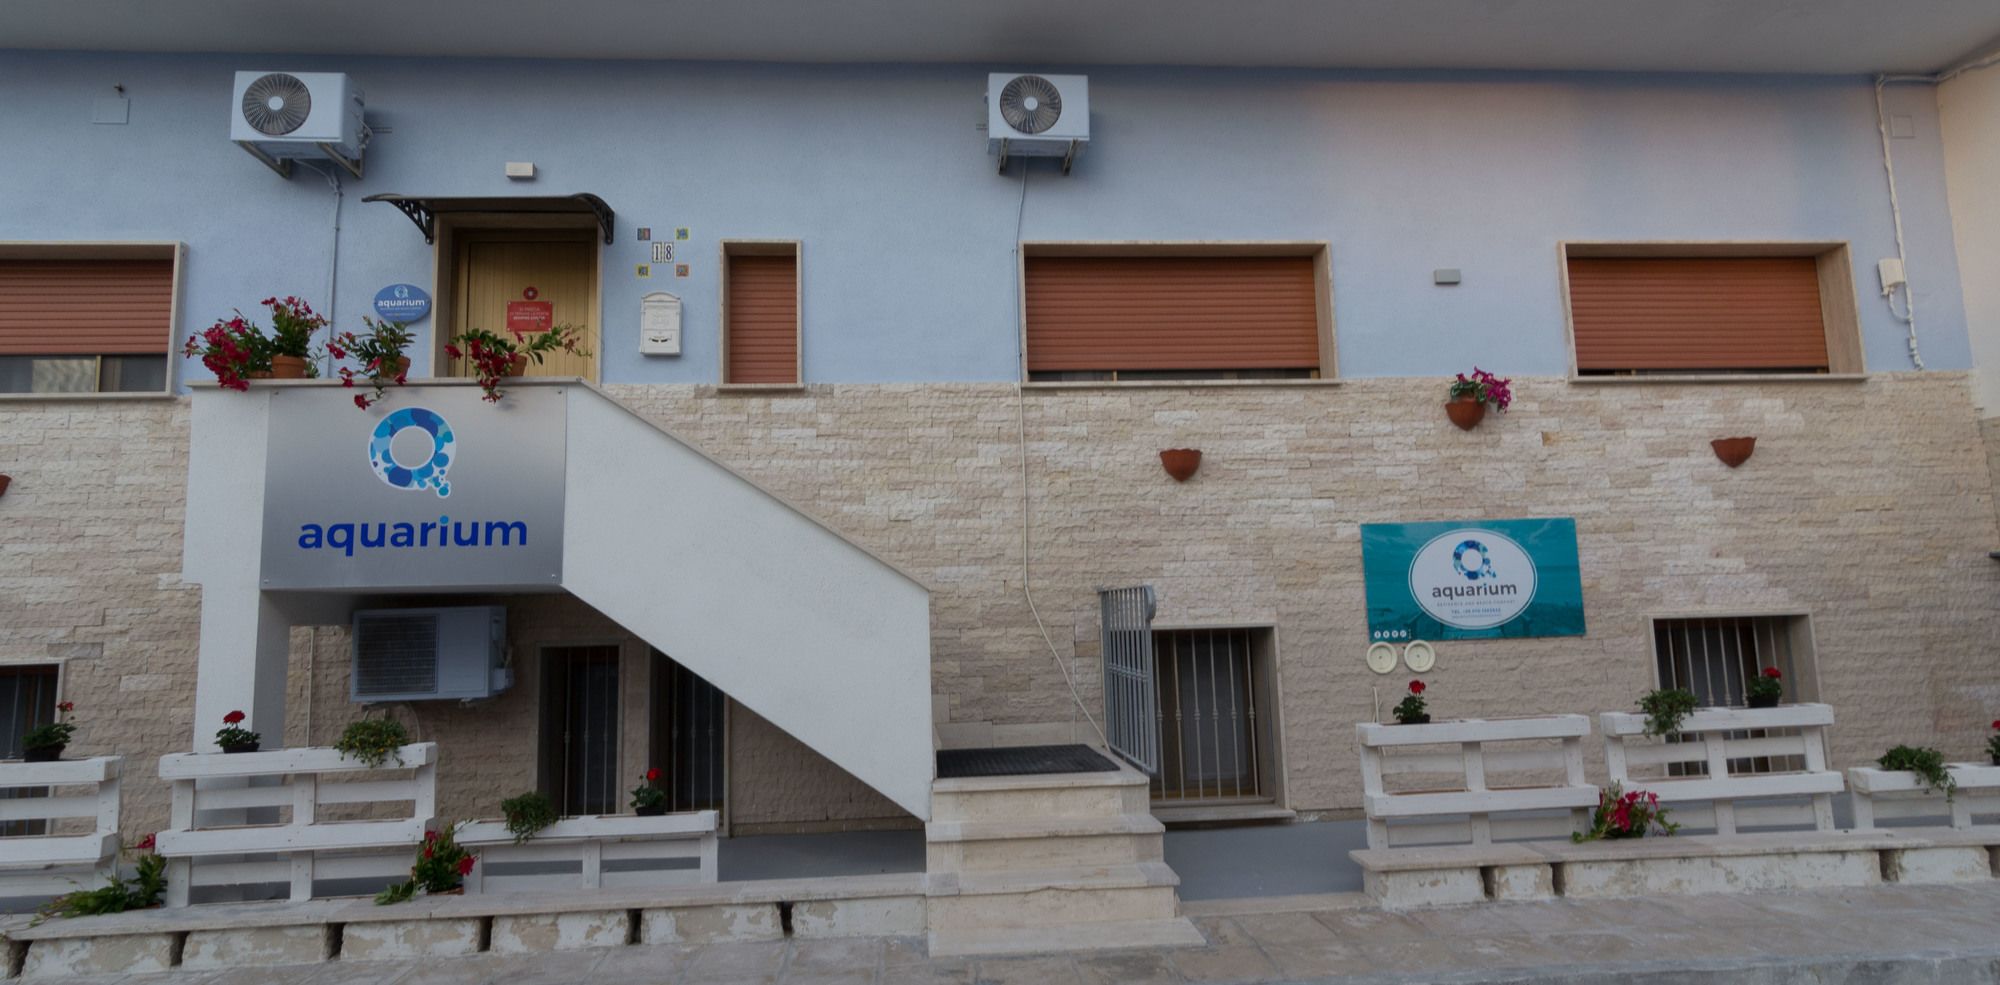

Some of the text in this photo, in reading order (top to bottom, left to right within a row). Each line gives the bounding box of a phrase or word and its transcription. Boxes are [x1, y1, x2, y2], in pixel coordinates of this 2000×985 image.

[654, 244, 673, 261] 18
[377, 298, 425, 308] aquarium
[297, 515, 528, 557] aquarium
[1431, 582, 1518, 600] aquarium
